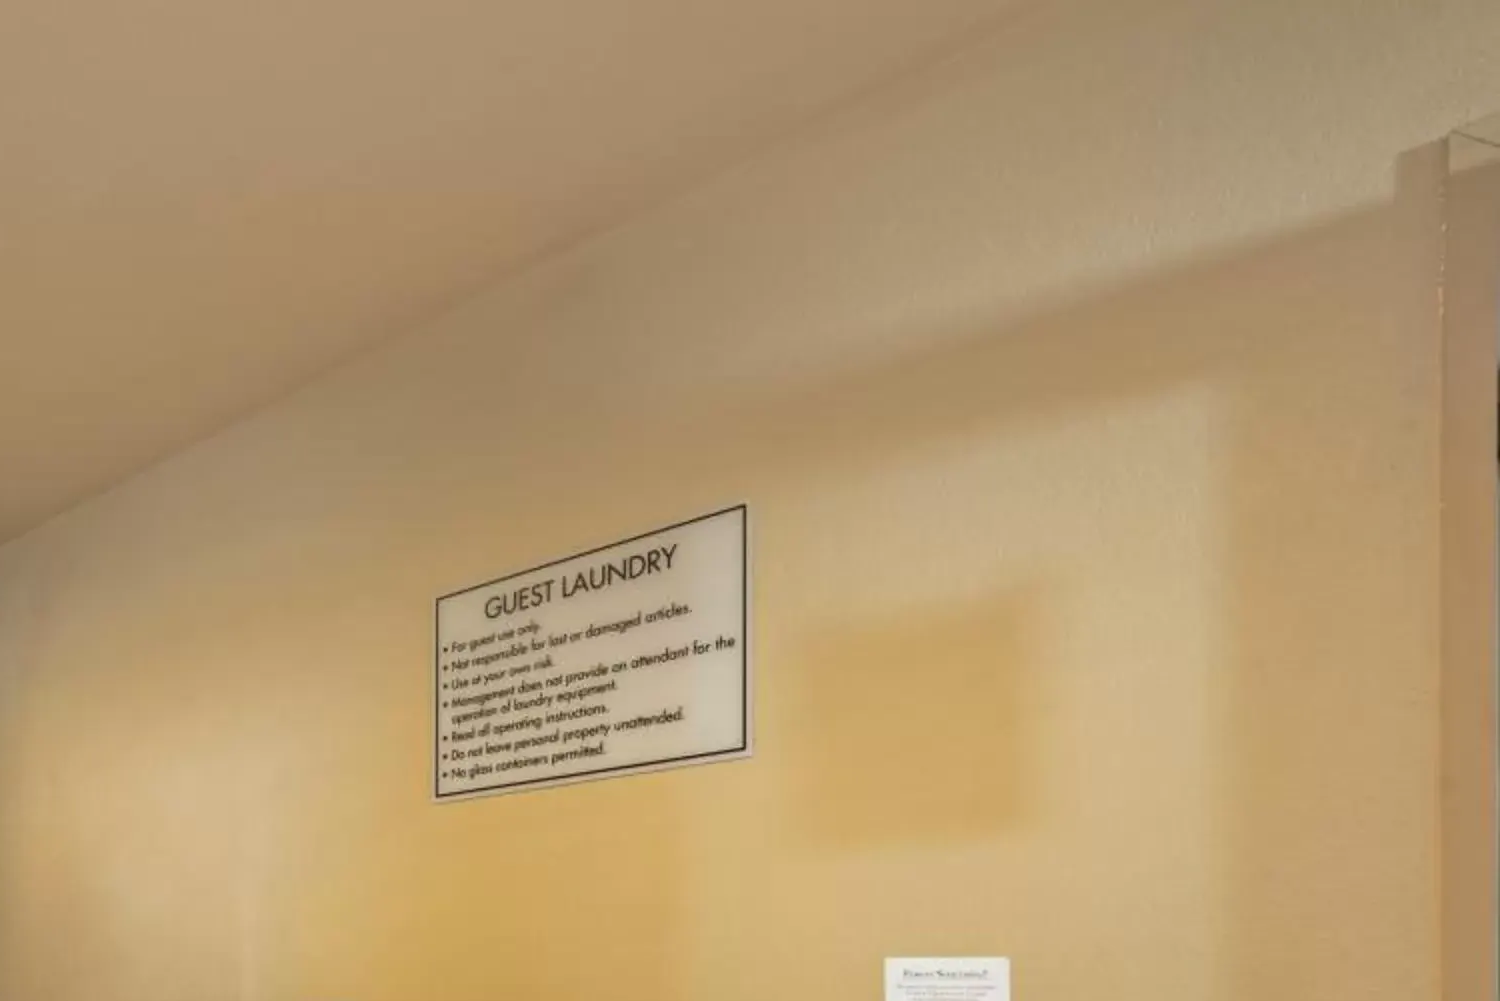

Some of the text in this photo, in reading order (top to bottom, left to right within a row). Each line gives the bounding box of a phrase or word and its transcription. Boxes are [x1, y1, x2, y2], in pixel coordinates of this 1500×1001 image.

[484, 543, 677, 619] GUEST LAUNDRY
[451, 602, 693, 672] Not responsible for lost or damaged articles.
[451, 641, 466, 653] For
[469, 633, 495, 651] guest
[498, 629, 515, 641] use
[451, 635, 735, 708] Management does not provide an attendant for the
[451, 678, 469, 691] Use
[471, 674, 481, 685] at
[484, 670, 506, 685] your
[509, 664, 531, 677] own
[451, 679, 617, 728] operation of laundry equipment.
[451, 704, 609, 742] Read all operating instructions.
[451, 705, 684, 761] Do not leave personal property unattended.
[451, 766, 466, 778] No
[468, 763, 493, 780] glass
[495, 755, 548, 772] containers
